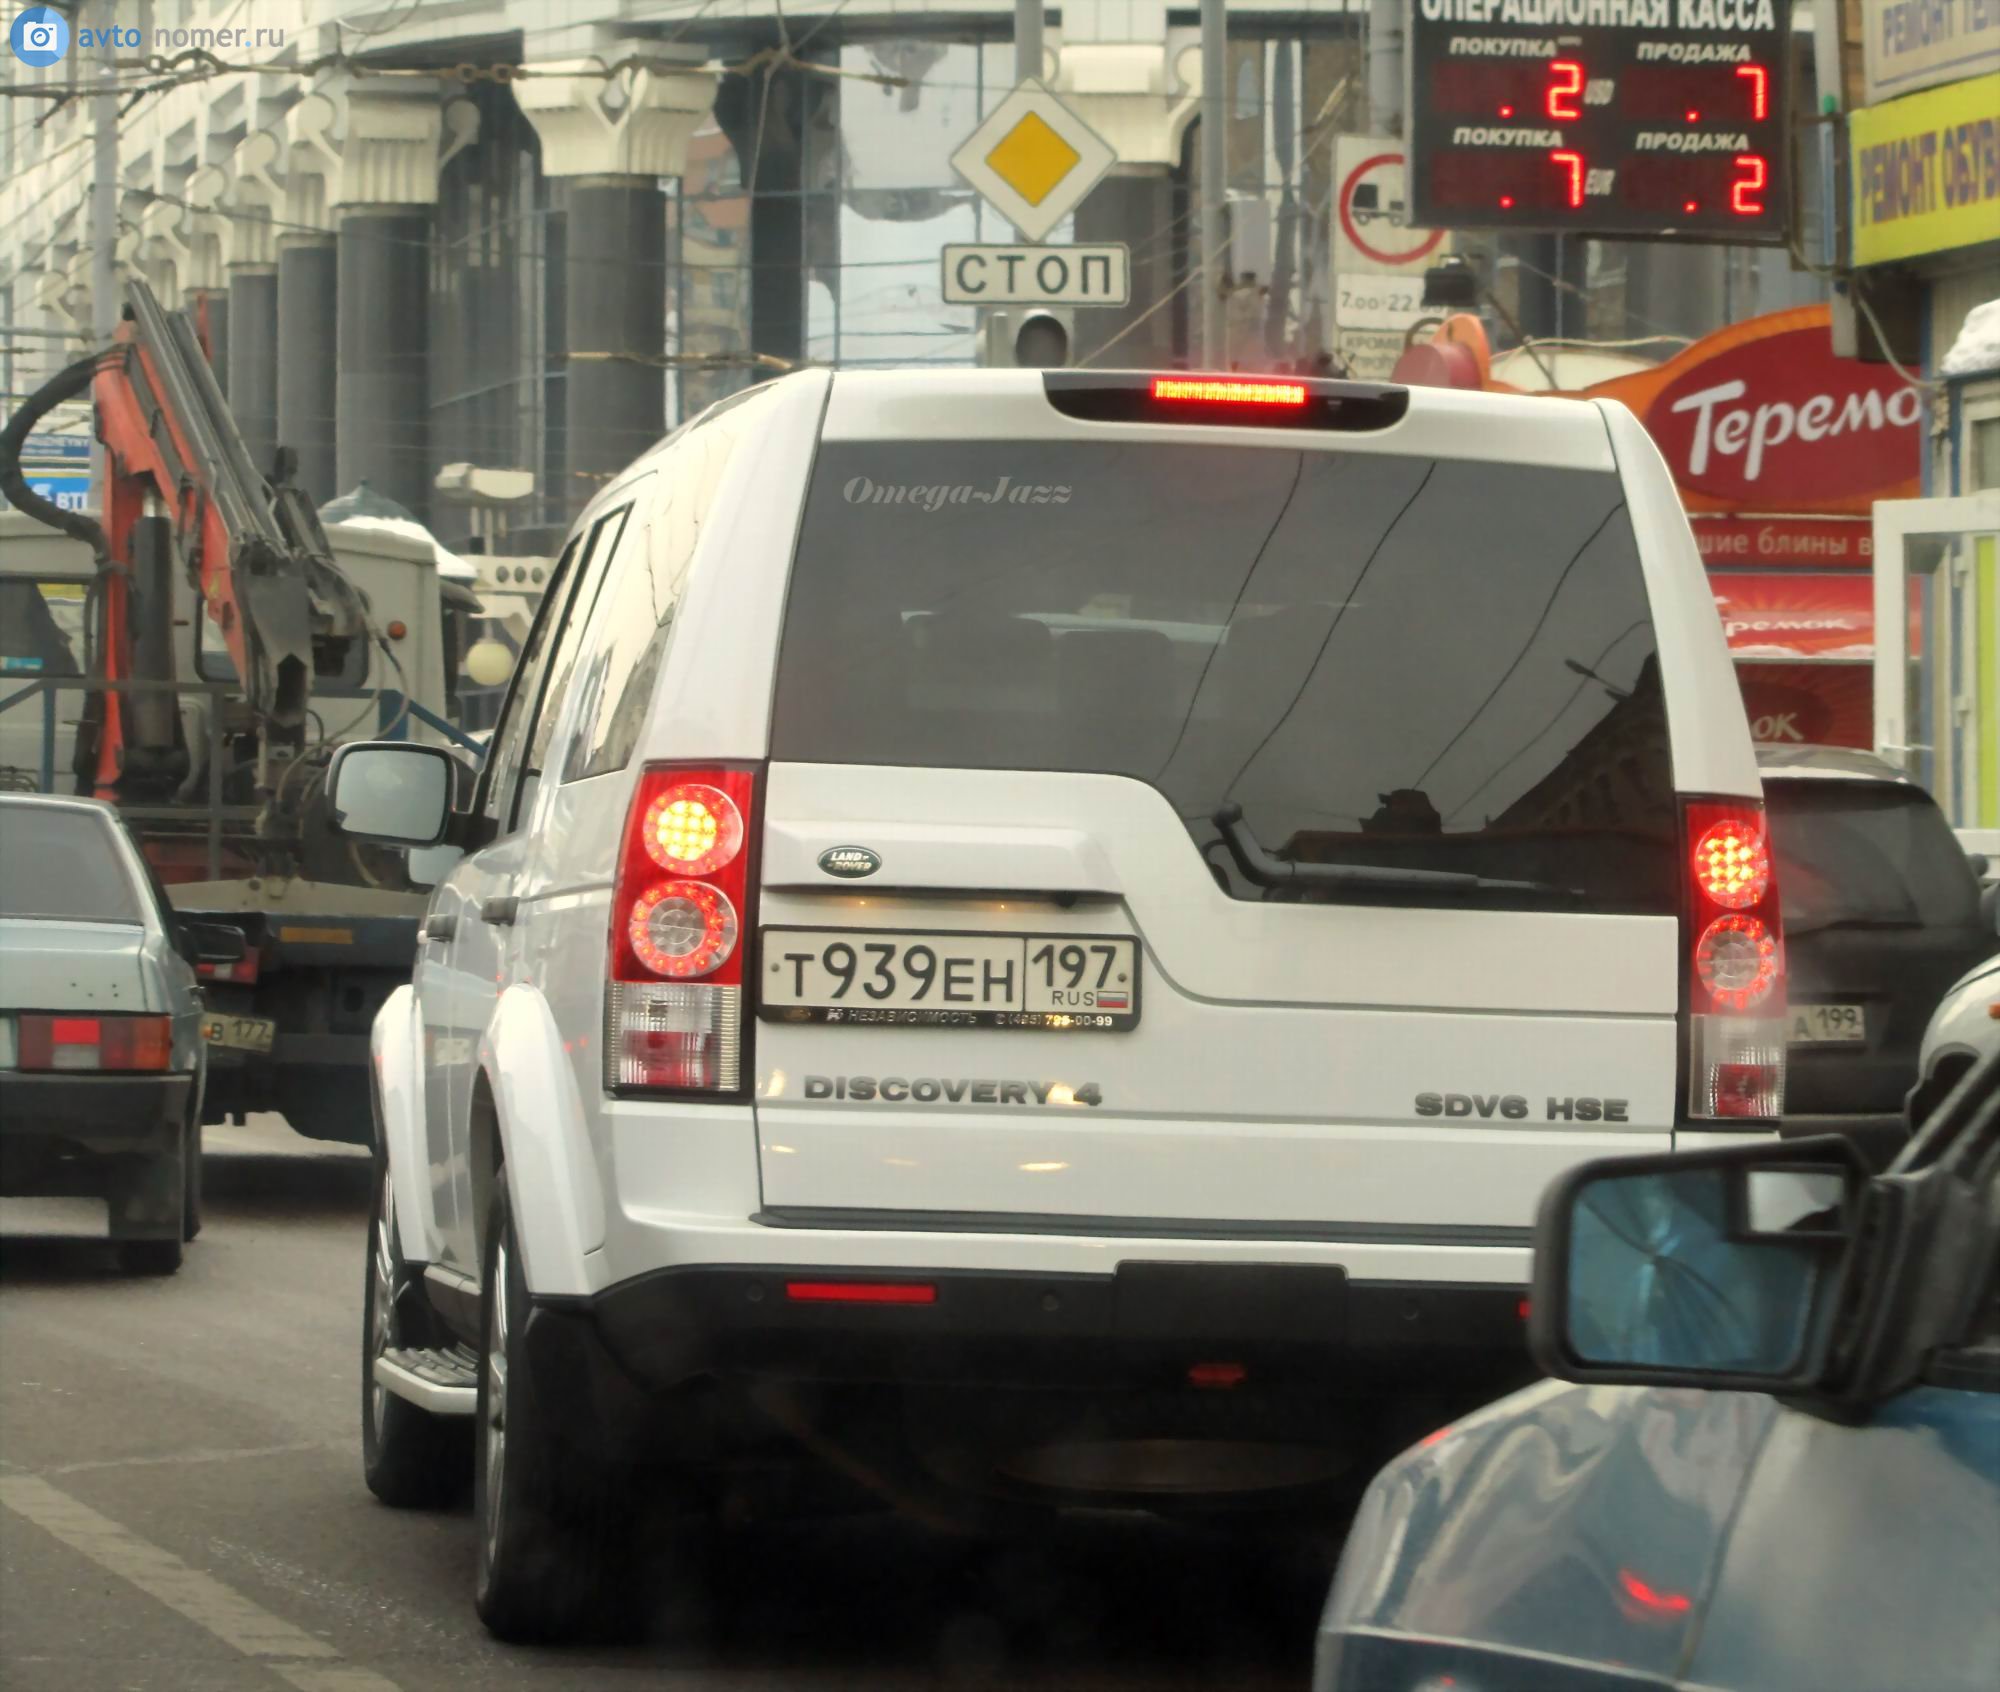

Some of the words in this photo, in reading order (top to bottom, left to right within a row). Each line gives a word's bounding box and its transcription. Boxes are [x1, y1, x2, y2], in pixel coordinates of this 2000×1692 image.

[1450, 37, 1557, 57] ПОКУПКА
[1637, 42, 1751, 63] ПРОДАЖА
[1453, 127, 1564, 147] ПОКУПКА
[1635, 132, 1749, 153] ПРОДАЖА
[1859, 130, 1937, 227] РЕМОНТ
[955, 254, 1110, 294] СТОП
[843, 475, 1072, 512] Omega-Jazz
[1031, 944, 1116, 988] 197
[1051, 990, 1095, 1006] RUS
[1415, 1092, 1529, 1121] SDV6
[1546, 1097, 1629, 1122] HSE
